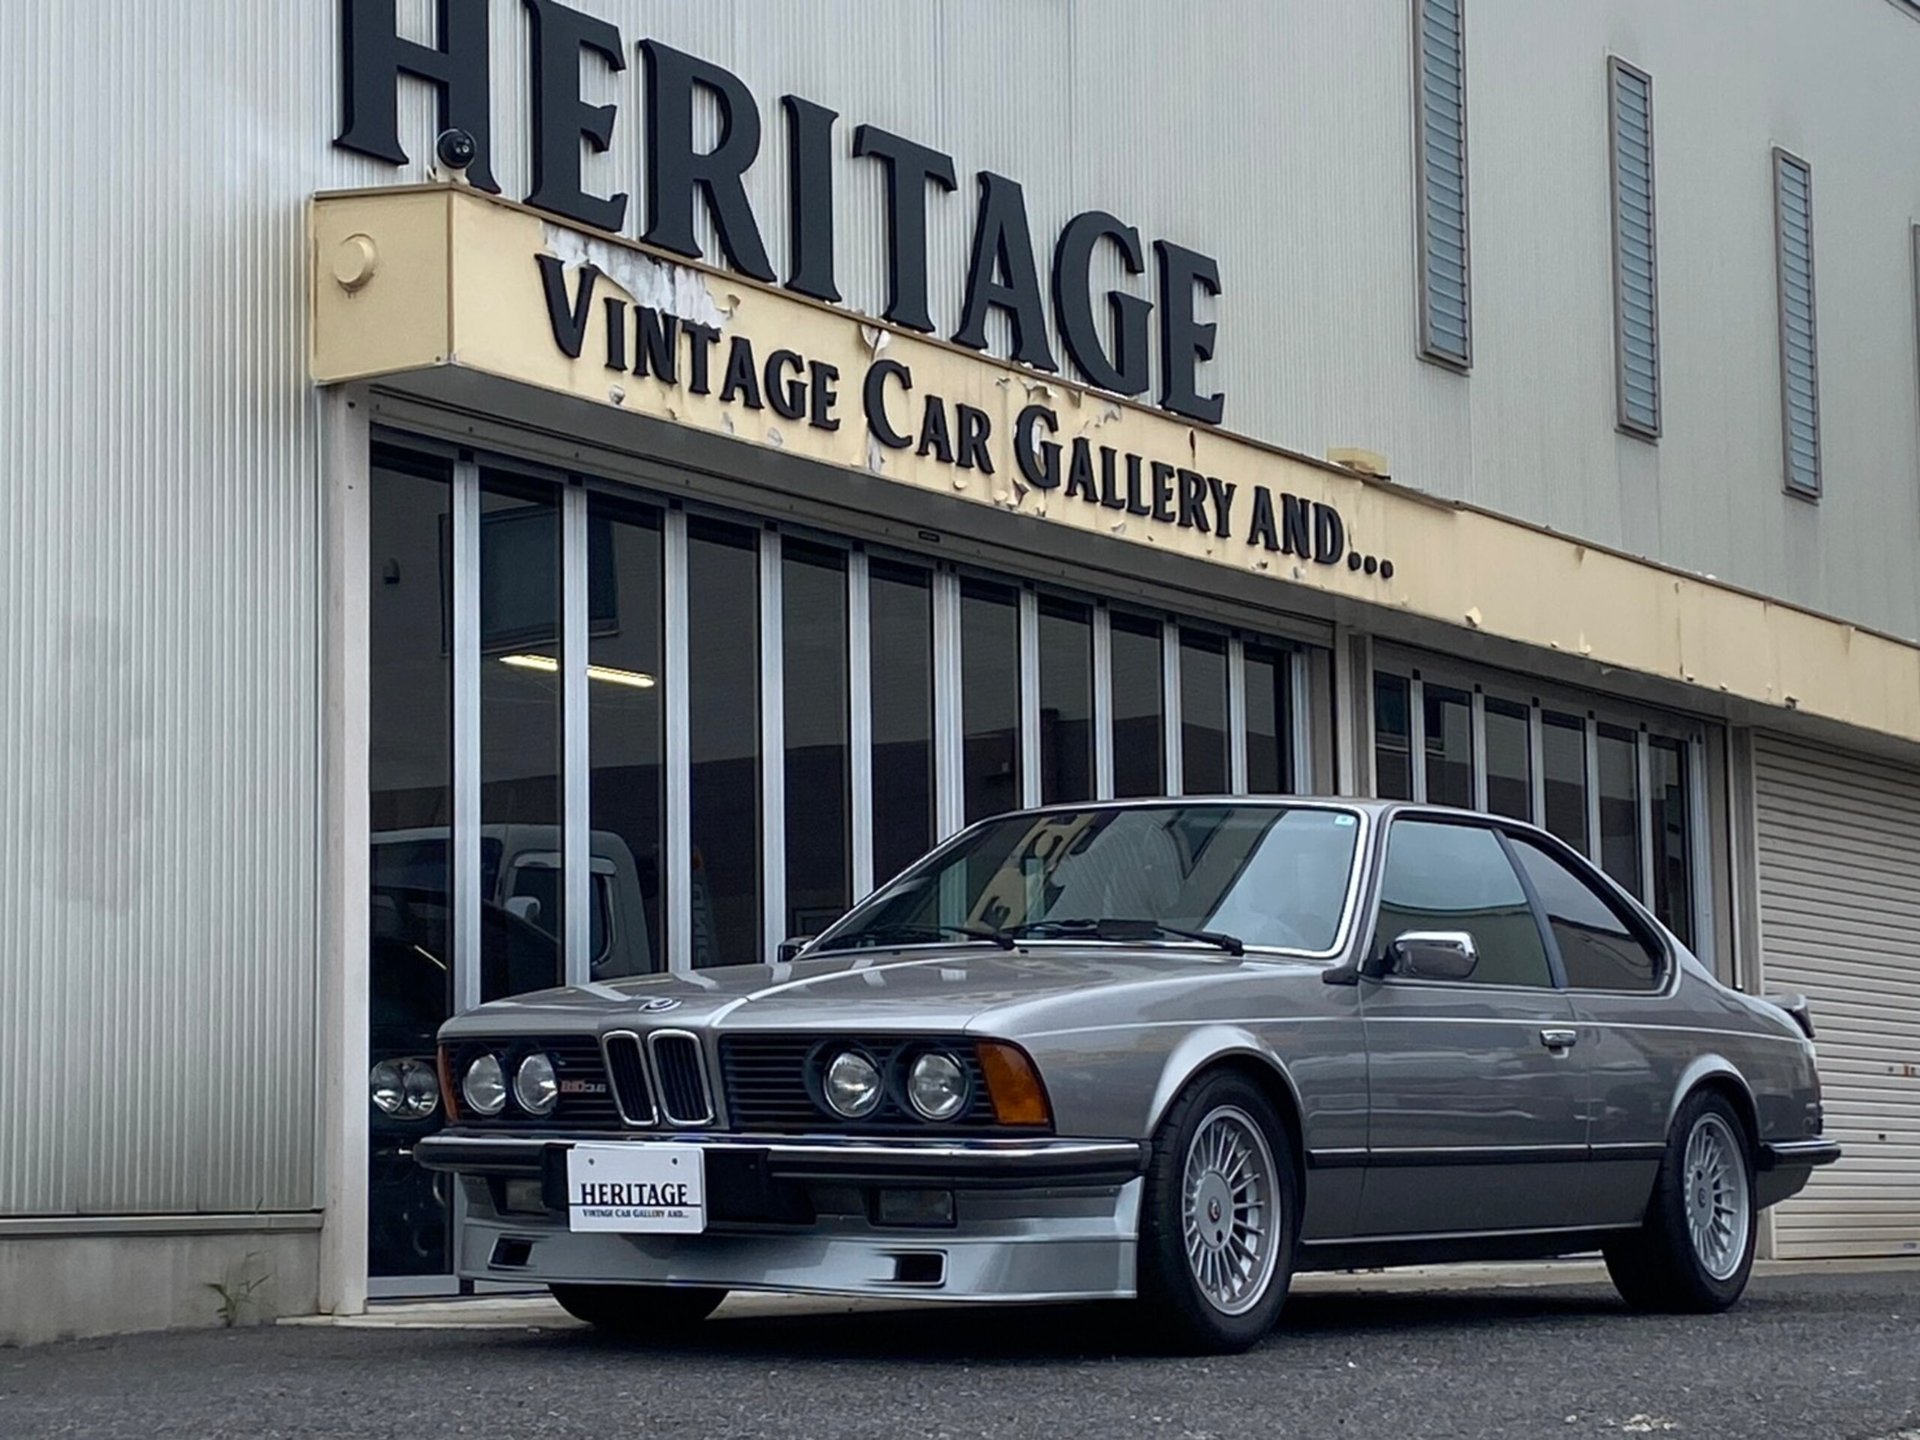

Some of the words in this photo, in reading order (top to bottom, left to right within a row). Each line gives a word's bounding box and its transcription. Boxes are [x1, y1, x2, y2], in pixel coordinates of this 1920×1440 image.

[333, 0, 1226, 425] HERITAGE
[533, 253, 841, 432] VINTAGE
[862, 358, 995, 475] CAR
[1013, 404, 1238, 539] GALLERY
[1247, 485, 1395, 579] AND...
[580, 1182, 688, 1206] HERITAGE
